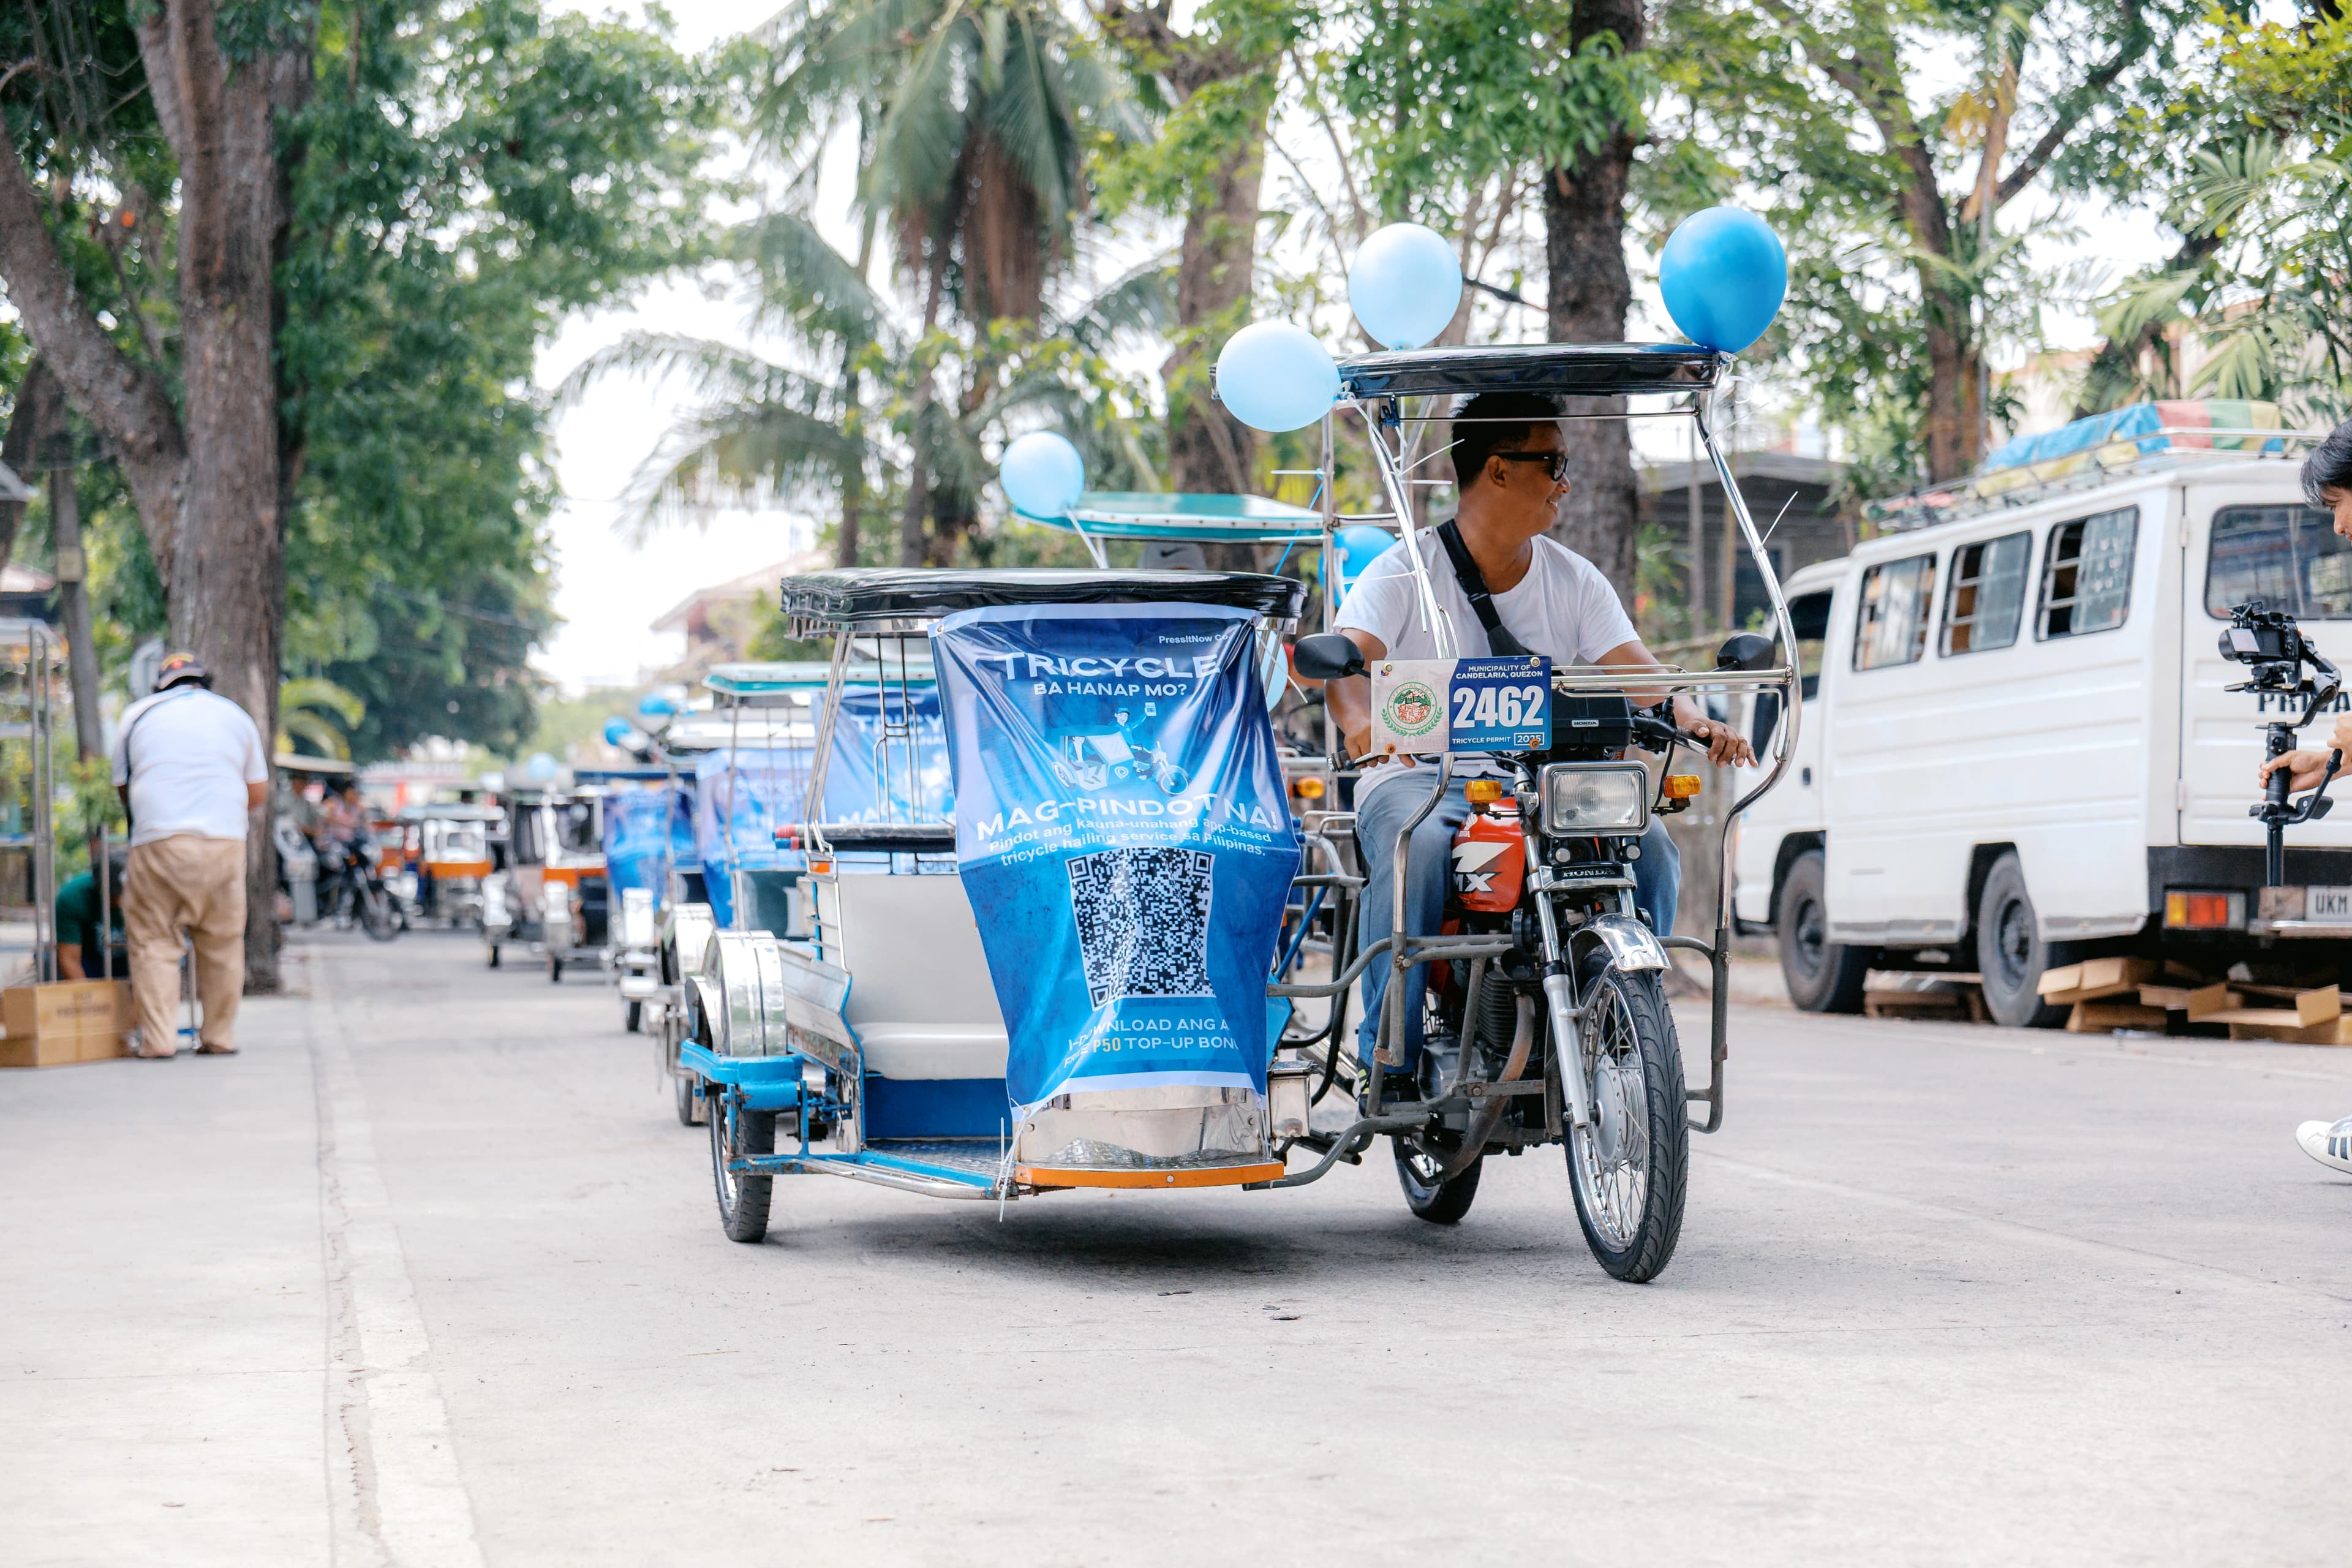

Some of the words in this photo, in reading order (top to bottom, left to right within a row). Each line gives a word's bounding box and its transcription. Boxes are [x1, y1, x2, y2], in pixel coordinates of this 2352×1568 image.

[1159, 635, 1213, 643] PressItNow
[993, 652, 1221, 680] TRICYCLE
[1034, 683, 1063, 696] BA
[1068, 682, 1140, 696] HANAP
[1144, 684, 1187, 696] MO?
[1453, 685, 1544, 728] 2462
[977, 793, 1218, 841] MAG-PINDOT
[1224, 798, 1278, 831] NA!
[990, 829, 1039, 852] Pindot
[1043, 823, 1072, 838] ang
[1077, 818, 1199, 829] kauna-unahang
[1203, 819, 1272, 842] app-based
[1001, 843, 1058, 866] tricycle
[1063, 833, 1116, 849] hailing
[1121, 831, 1177, 841] service
[1183, 833, 1200, 842] sa
[1204, 835, 1266, 856] Pilipinas.
[1562, 869, 1616, 877] HONDA
[2316, 894, 2347, 914] UKM
[1177, 1019, 1216, 1030] ANG
[1093, 1037, 1121, 1054] P50
[1125, 1037, 1194, 1050] TOP-UP
